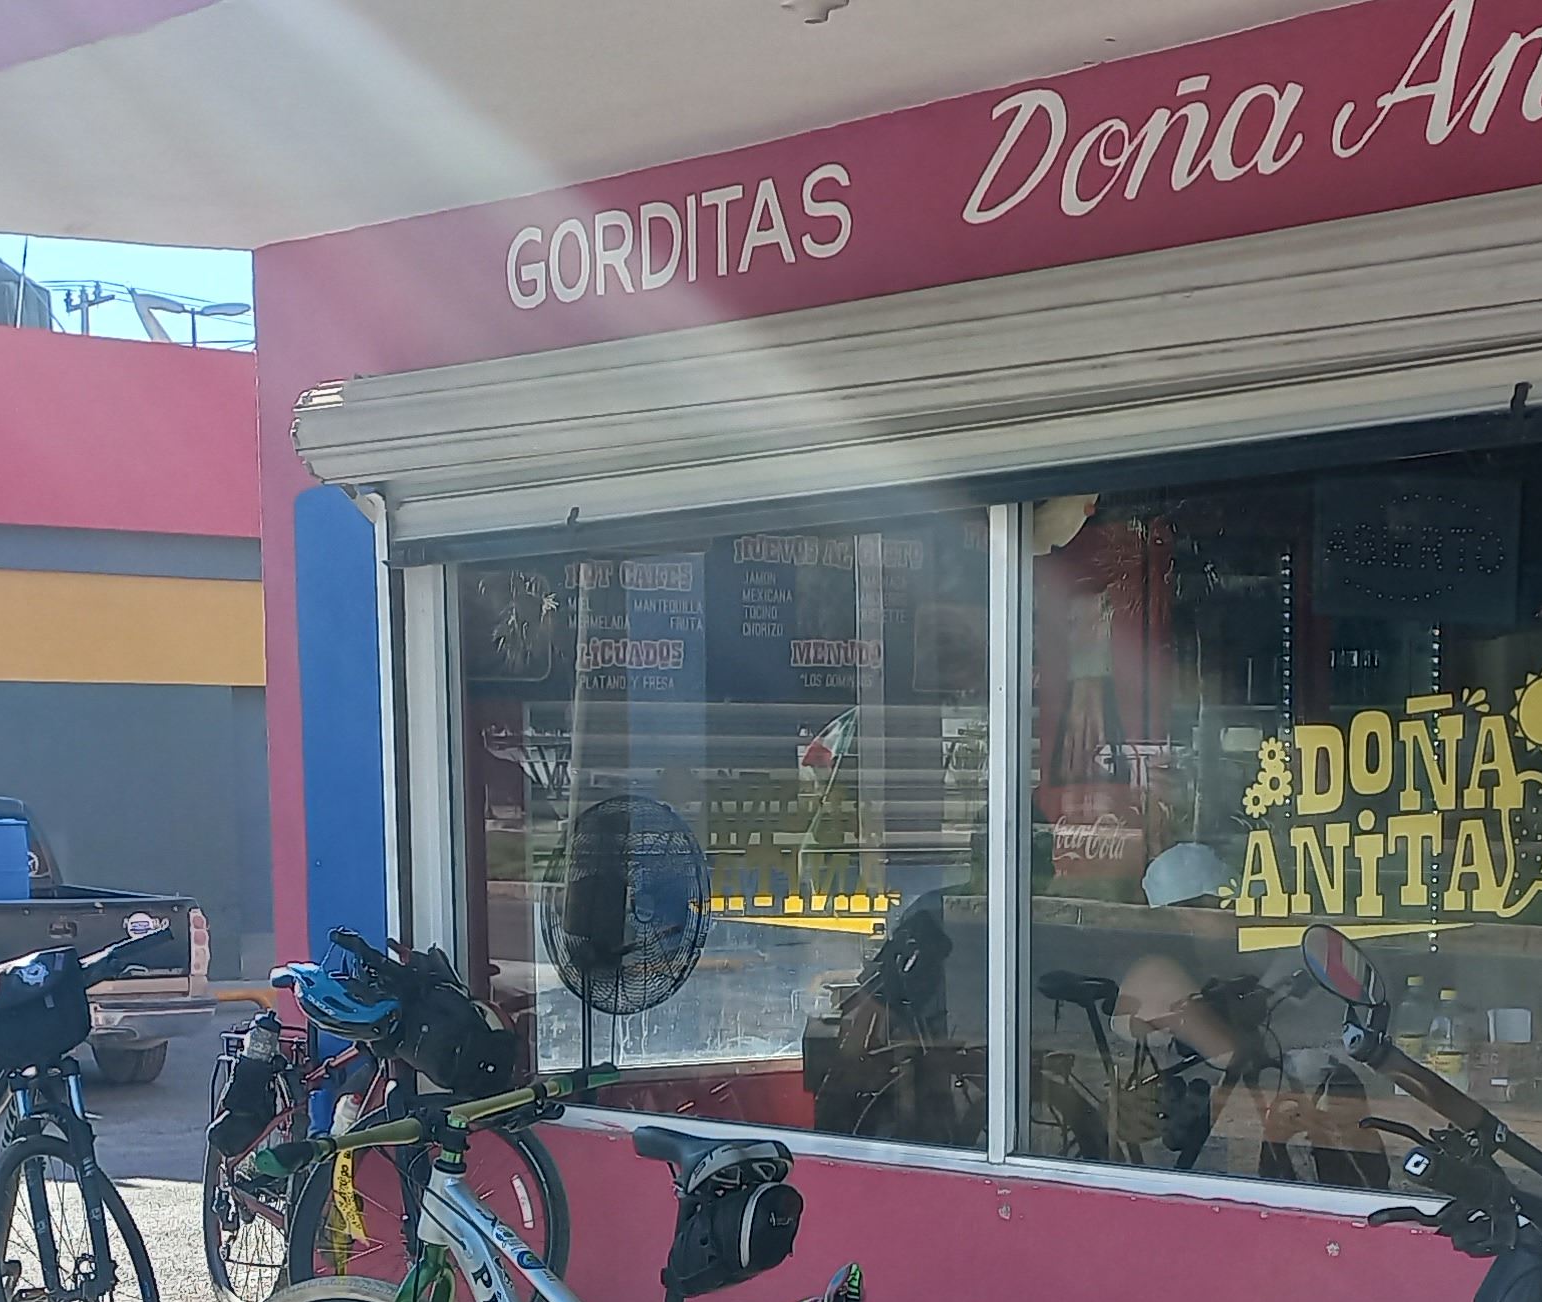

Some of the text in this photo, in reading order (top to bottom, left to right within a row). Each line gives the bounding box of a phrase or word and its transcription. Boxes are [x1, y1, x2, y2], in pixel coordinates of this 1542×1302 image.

[963, 74, 1303, 225] Doña
[505, 160, 853, 309] GORDITAS
[823, 541, 853, 570] AL
[1325, 523, 1504, 573] ABIERTO
[742, 590, 793, 604] MEXICANA
[633, 600, 703, 614] MANTEQUILLA
[743, 606, 778, 621] TOCINO
[669, 617, 703, 632] FRUTA
[742, 624, 784, 637] CHORIZO
[790, 640, 883, 669] MENUDO
[580, 676, 675, 690] PLATANO Y FRESA
[825, 674, 873, 689] DOMINOS
[1295, 694, 1525, 816] DOÑA
